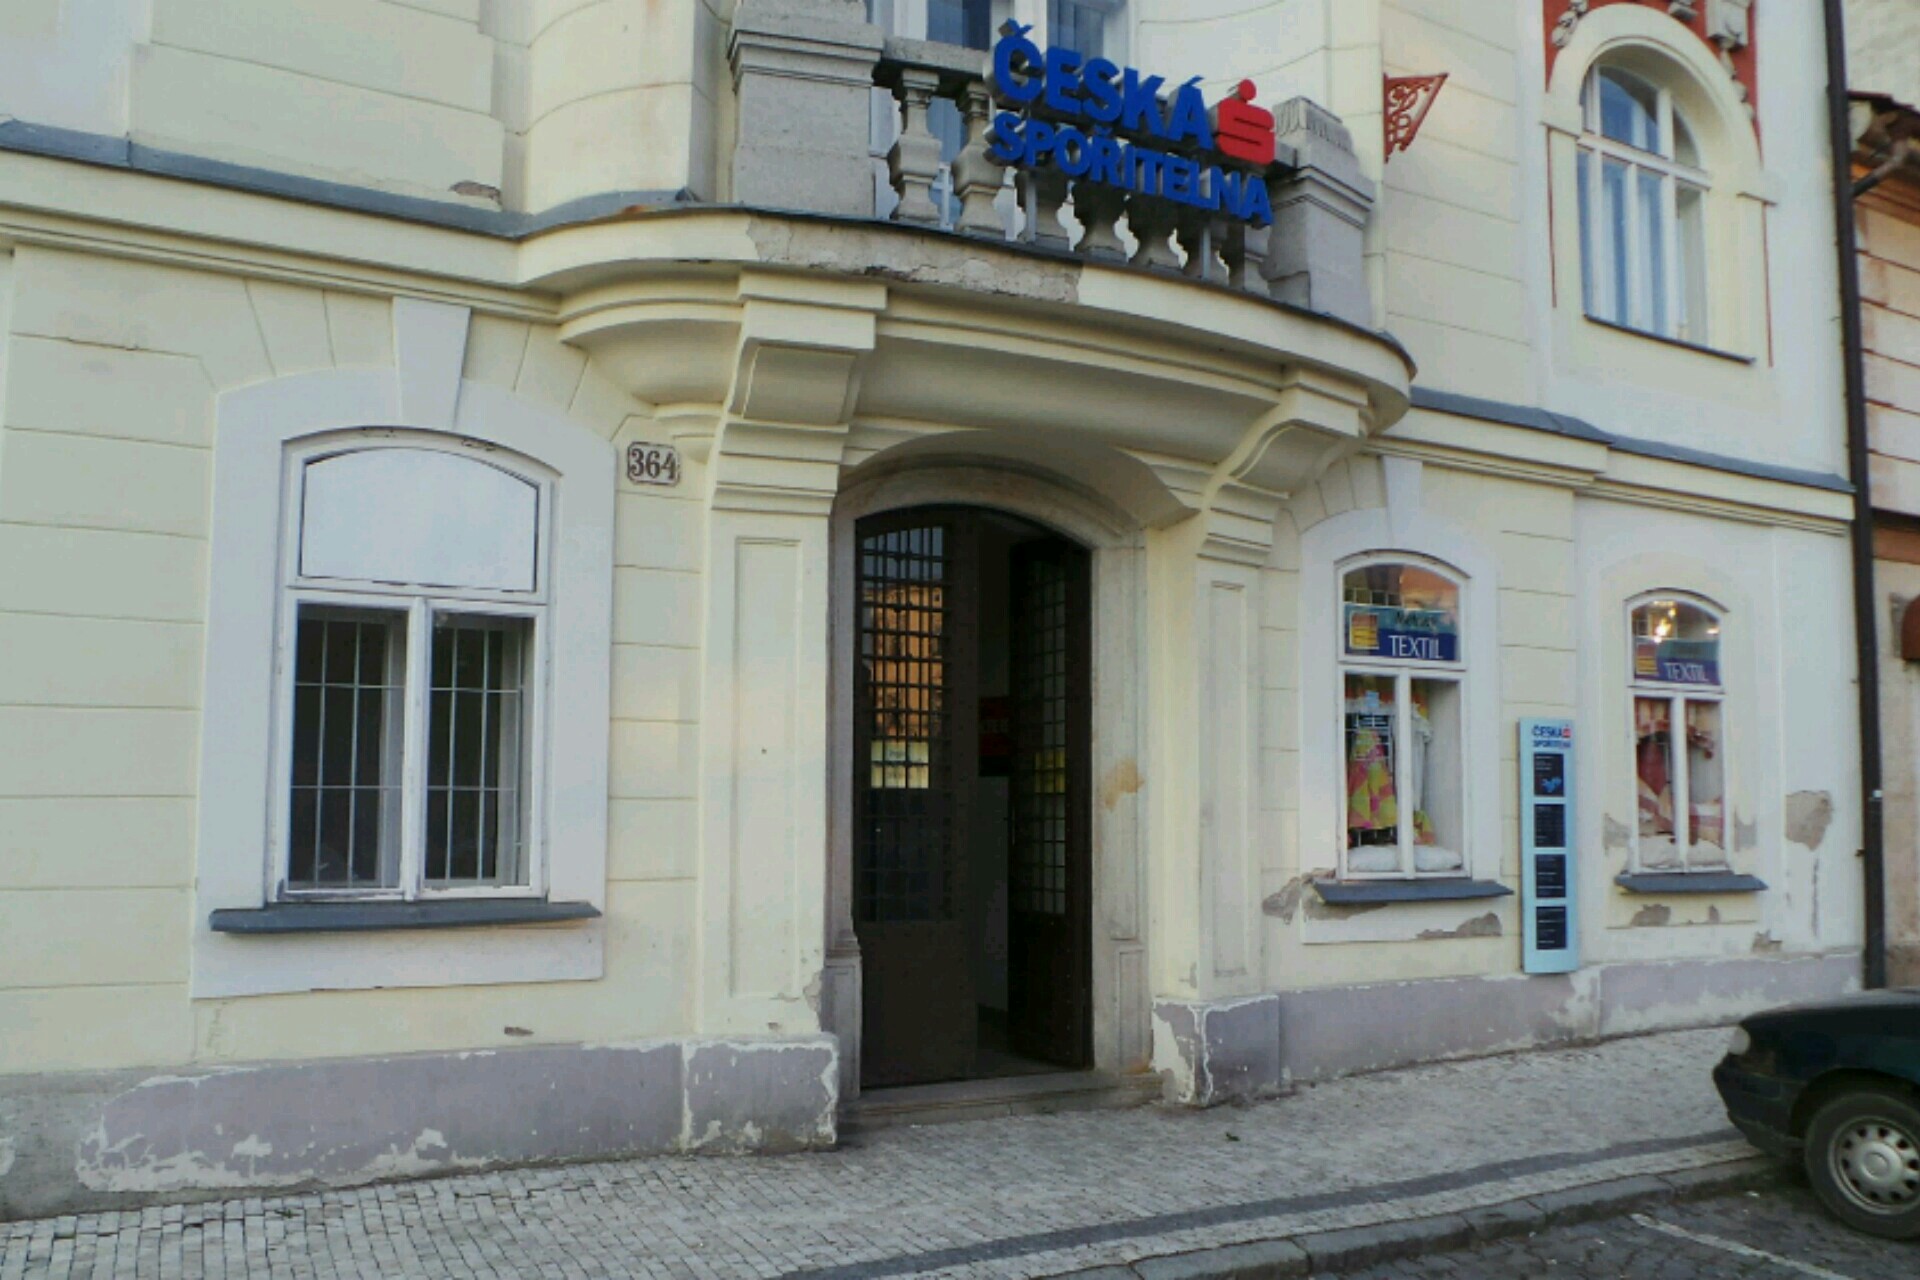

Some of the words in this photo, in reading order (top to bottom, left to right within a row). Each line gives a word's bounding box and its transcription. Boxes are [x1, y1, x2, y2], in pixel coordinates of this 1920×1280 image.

[994, 18, 1214, 150] ČESKÁ
[992, 112, 1273, 225] SPOŘITELNA
[631, 448, 676, 479] 364
[1388, 635, 1443, 659] TEXTIL
